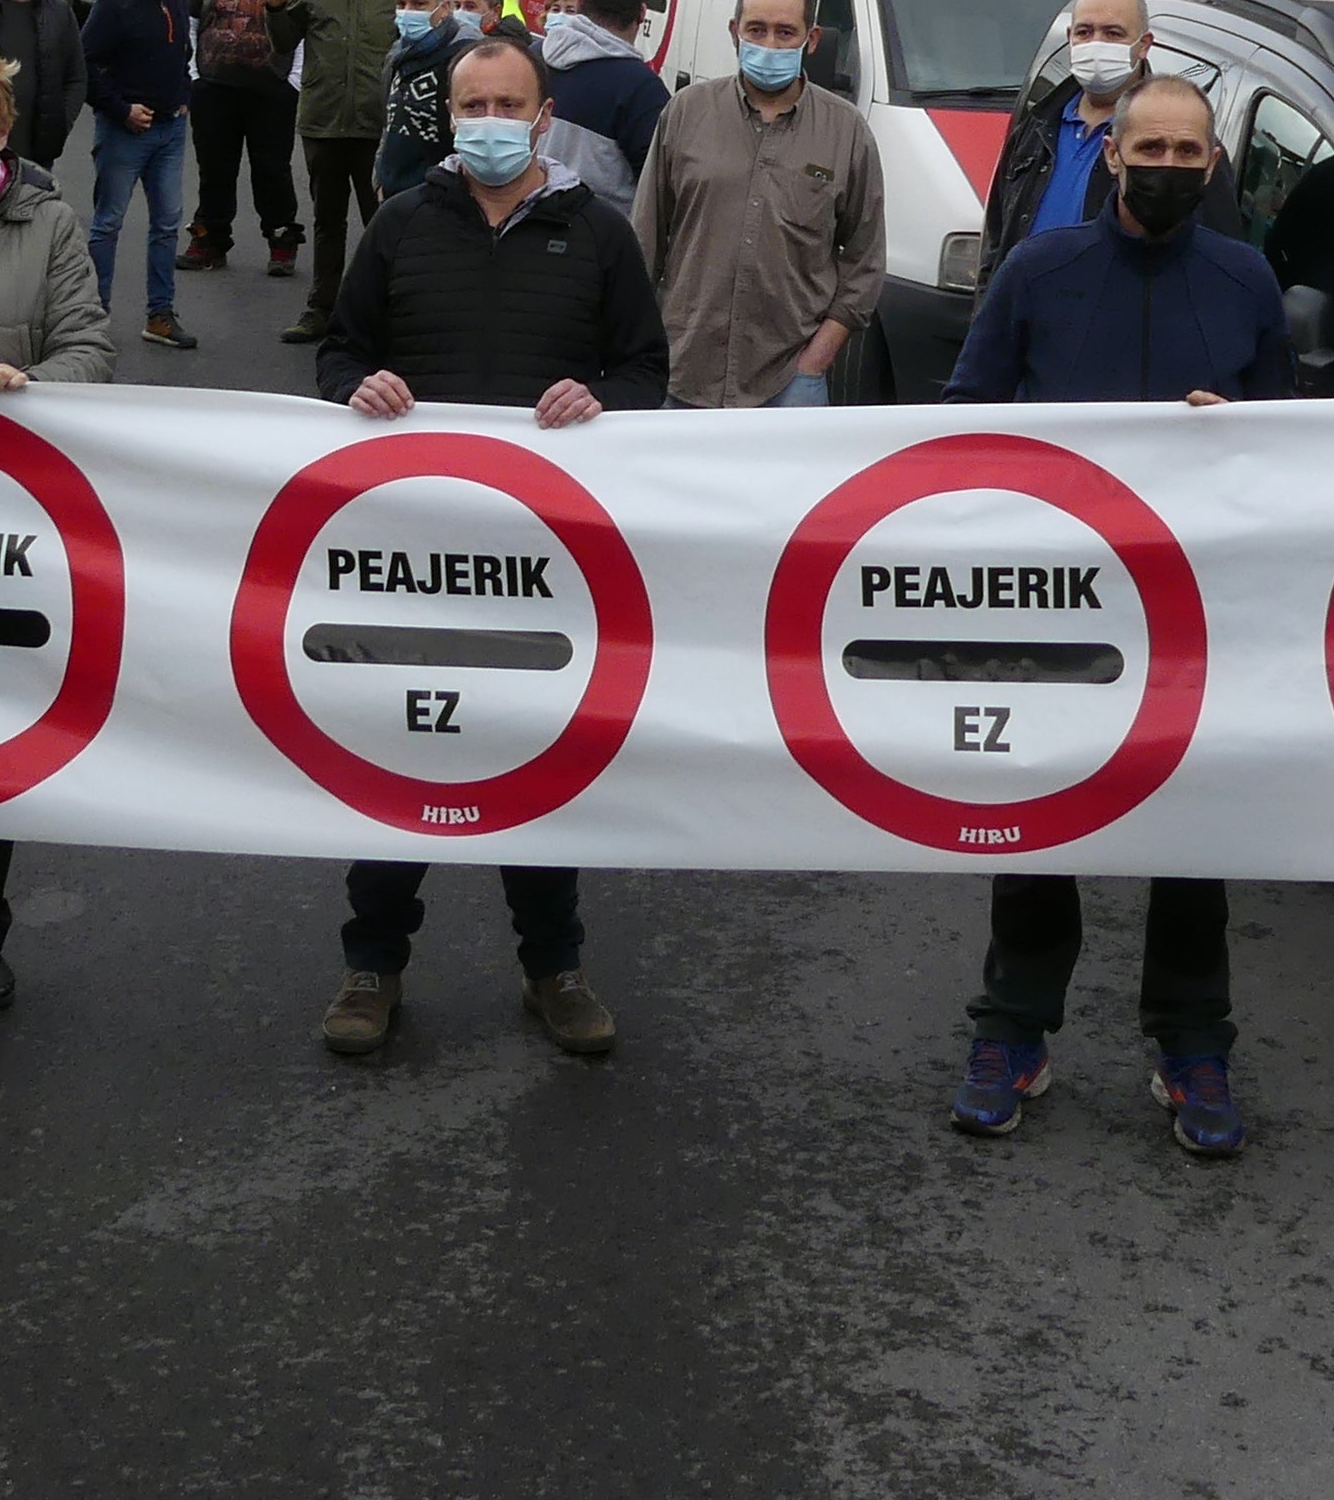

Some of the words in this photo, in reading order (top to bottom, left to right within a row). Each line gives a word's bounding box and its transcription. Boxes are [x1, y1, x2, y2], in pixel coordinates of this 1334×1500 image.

[327, 548, 554, 598] PEAJERIK
[861, 565, 1102, 609] PEAJERIK
[406, 689, 461, 734] EZ
[953, 706, 1011, 752] EZ
